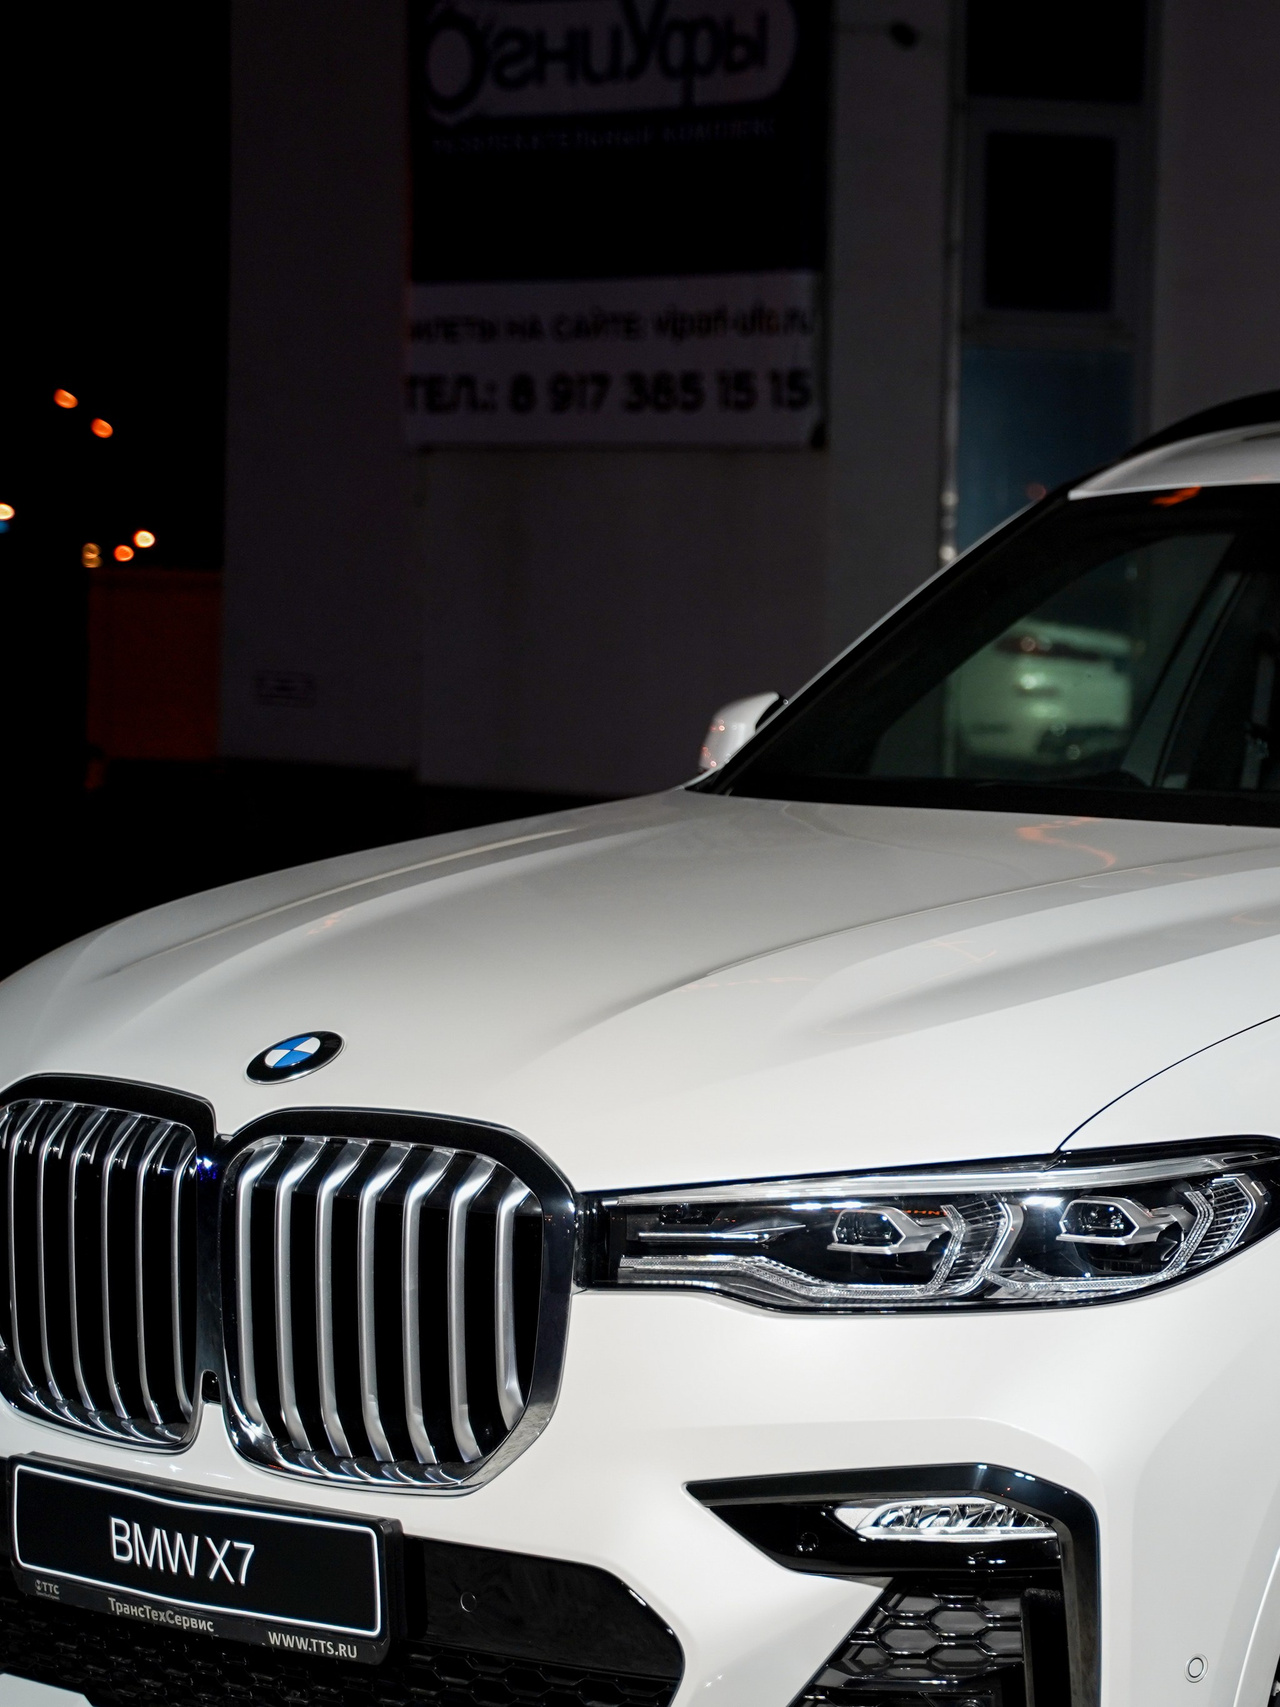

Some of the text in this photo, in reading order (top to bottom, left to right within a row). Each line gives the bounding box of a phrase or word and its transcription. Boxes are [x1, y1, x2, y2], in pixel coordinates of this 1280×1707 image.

[409, 315, 498, 343] ИЛЕТЫ
[505, 312, 544, 342] НА
[507, 371, 537, 415] 8
[547, 371, 612, 415] 917
[717, 368, 758, 412] 15
[770, 367, 812, 411] 15
[109, 1516, 256, 1586] BMW X7
[107, 1596, 215, 1633] ТрансТехСервис
[268, 1630, 358, 1660] WWW.TTS.RU
